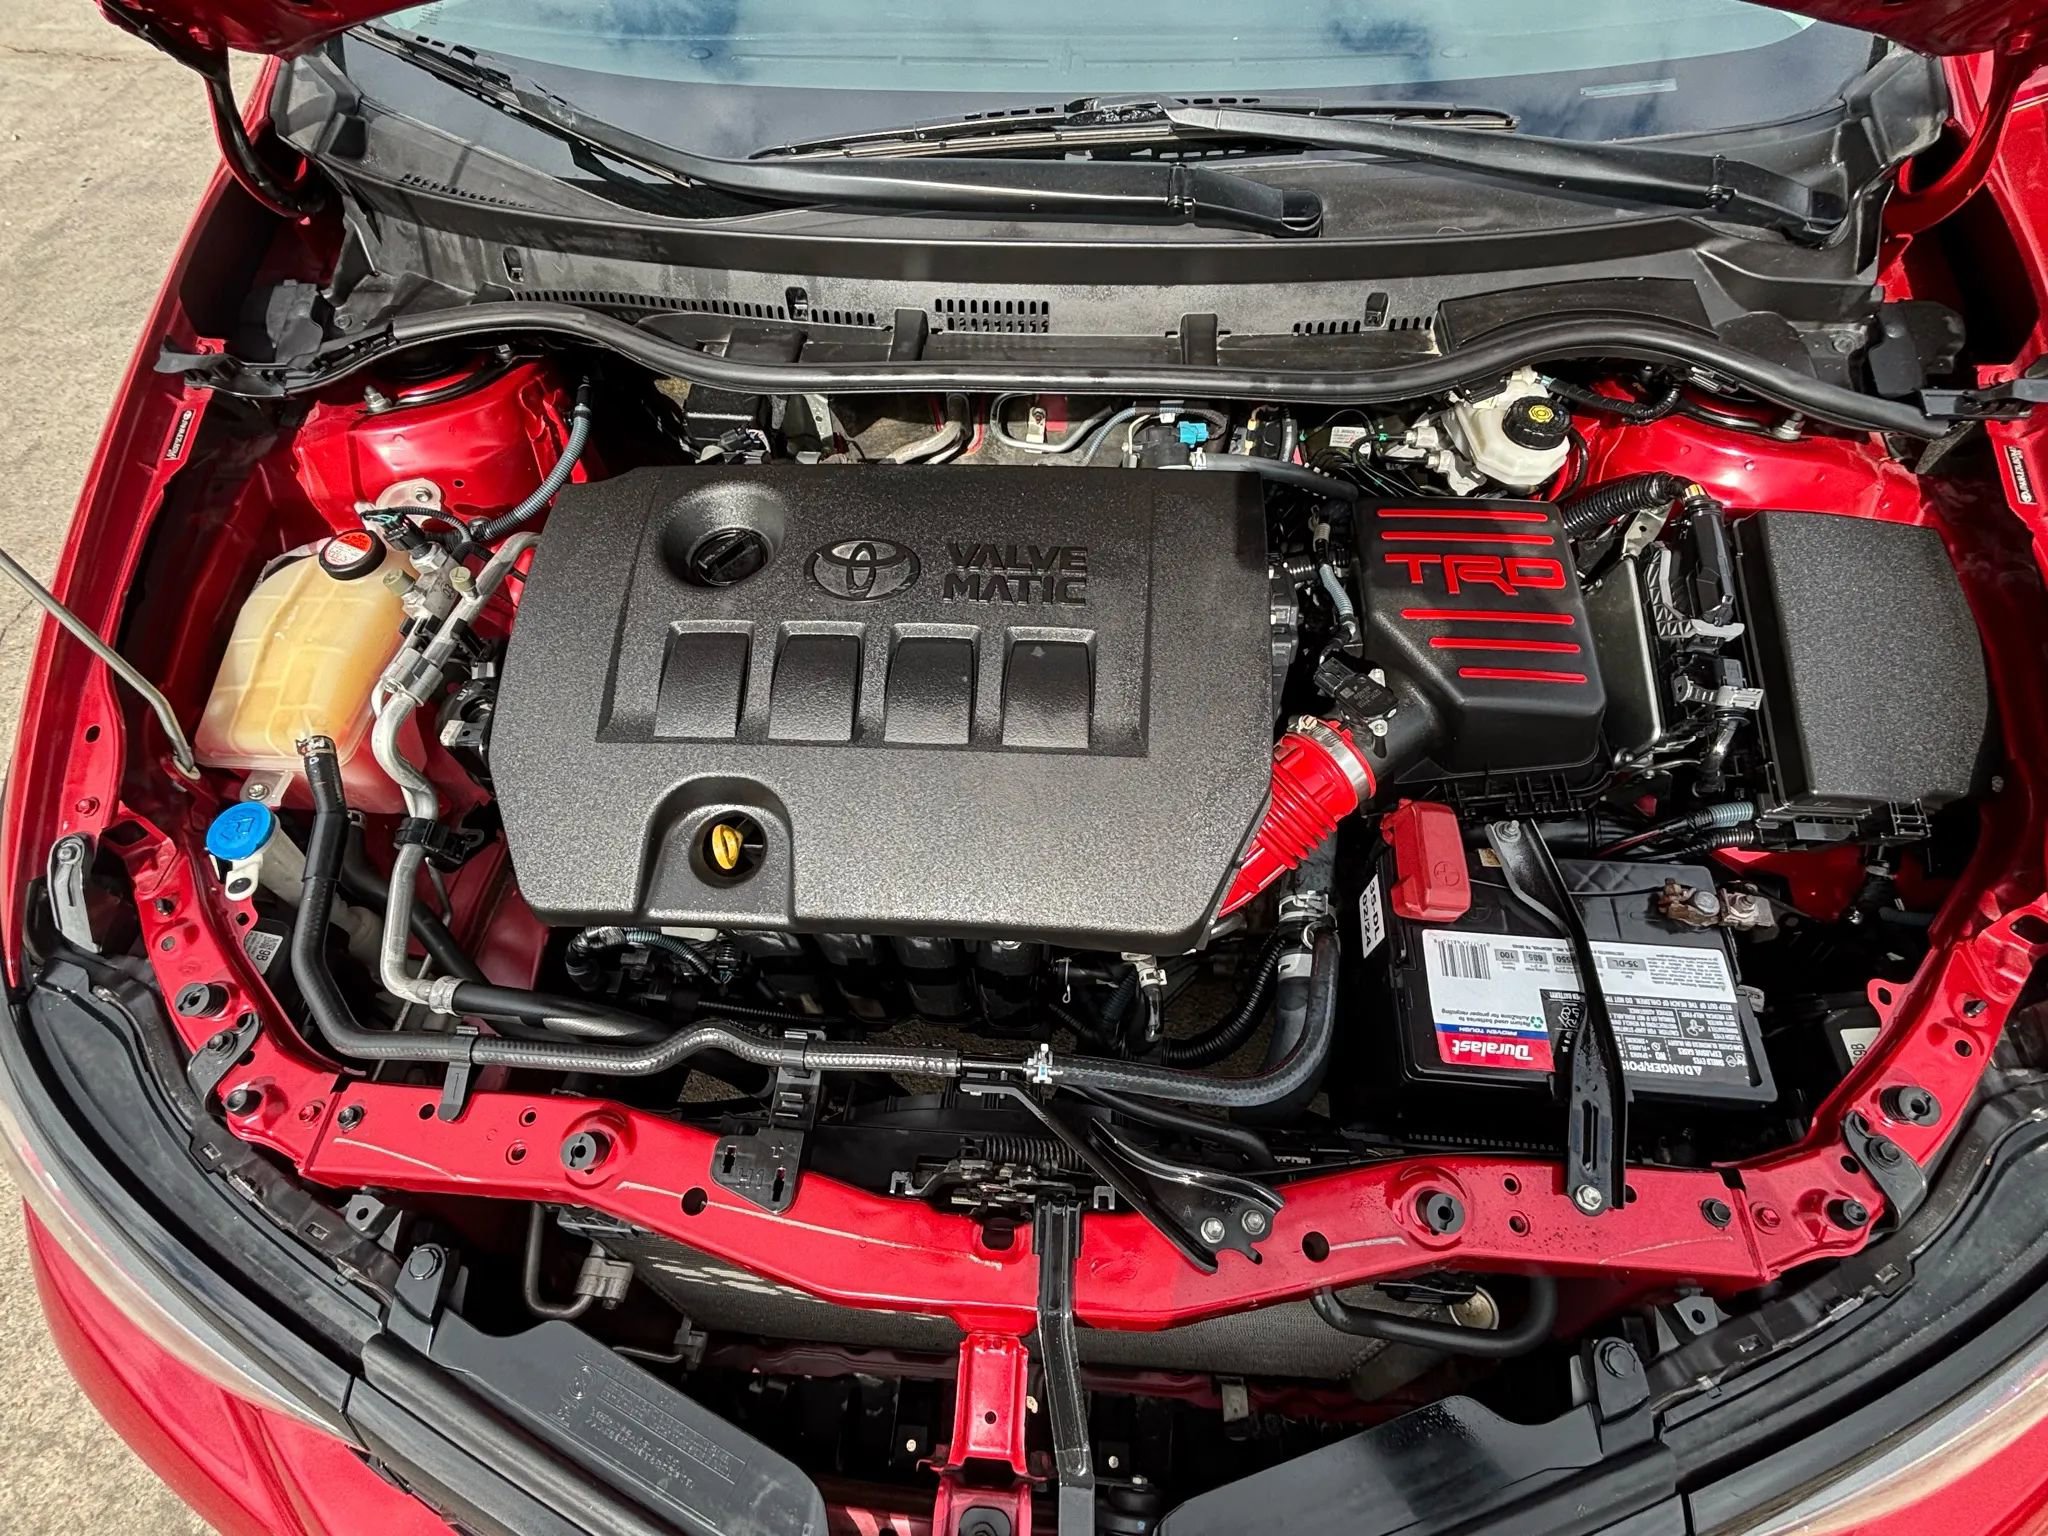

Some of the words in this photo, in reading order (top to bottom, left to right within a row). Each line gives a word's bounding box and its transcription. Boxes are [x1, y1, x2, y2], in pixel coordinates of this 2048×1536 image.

[948, 543, 1088, 573] VALVE
[1385, 553, 1567, 596] TRD
[942, 574, 1088, 605] MATIC
[1362, 893, 1373, 948] 02/24
[1369, 881, 1380, 941] 35-DL
[1500, 951, 1514, 959] 100
[1612, 959, 1639, 968] 35-DL
[1458, 1026, 1485, 1034] TOUGH
[1486, 1028, 1518, 1036] PROVEN
[1452, 1039, 1534, 1060] Duralast
